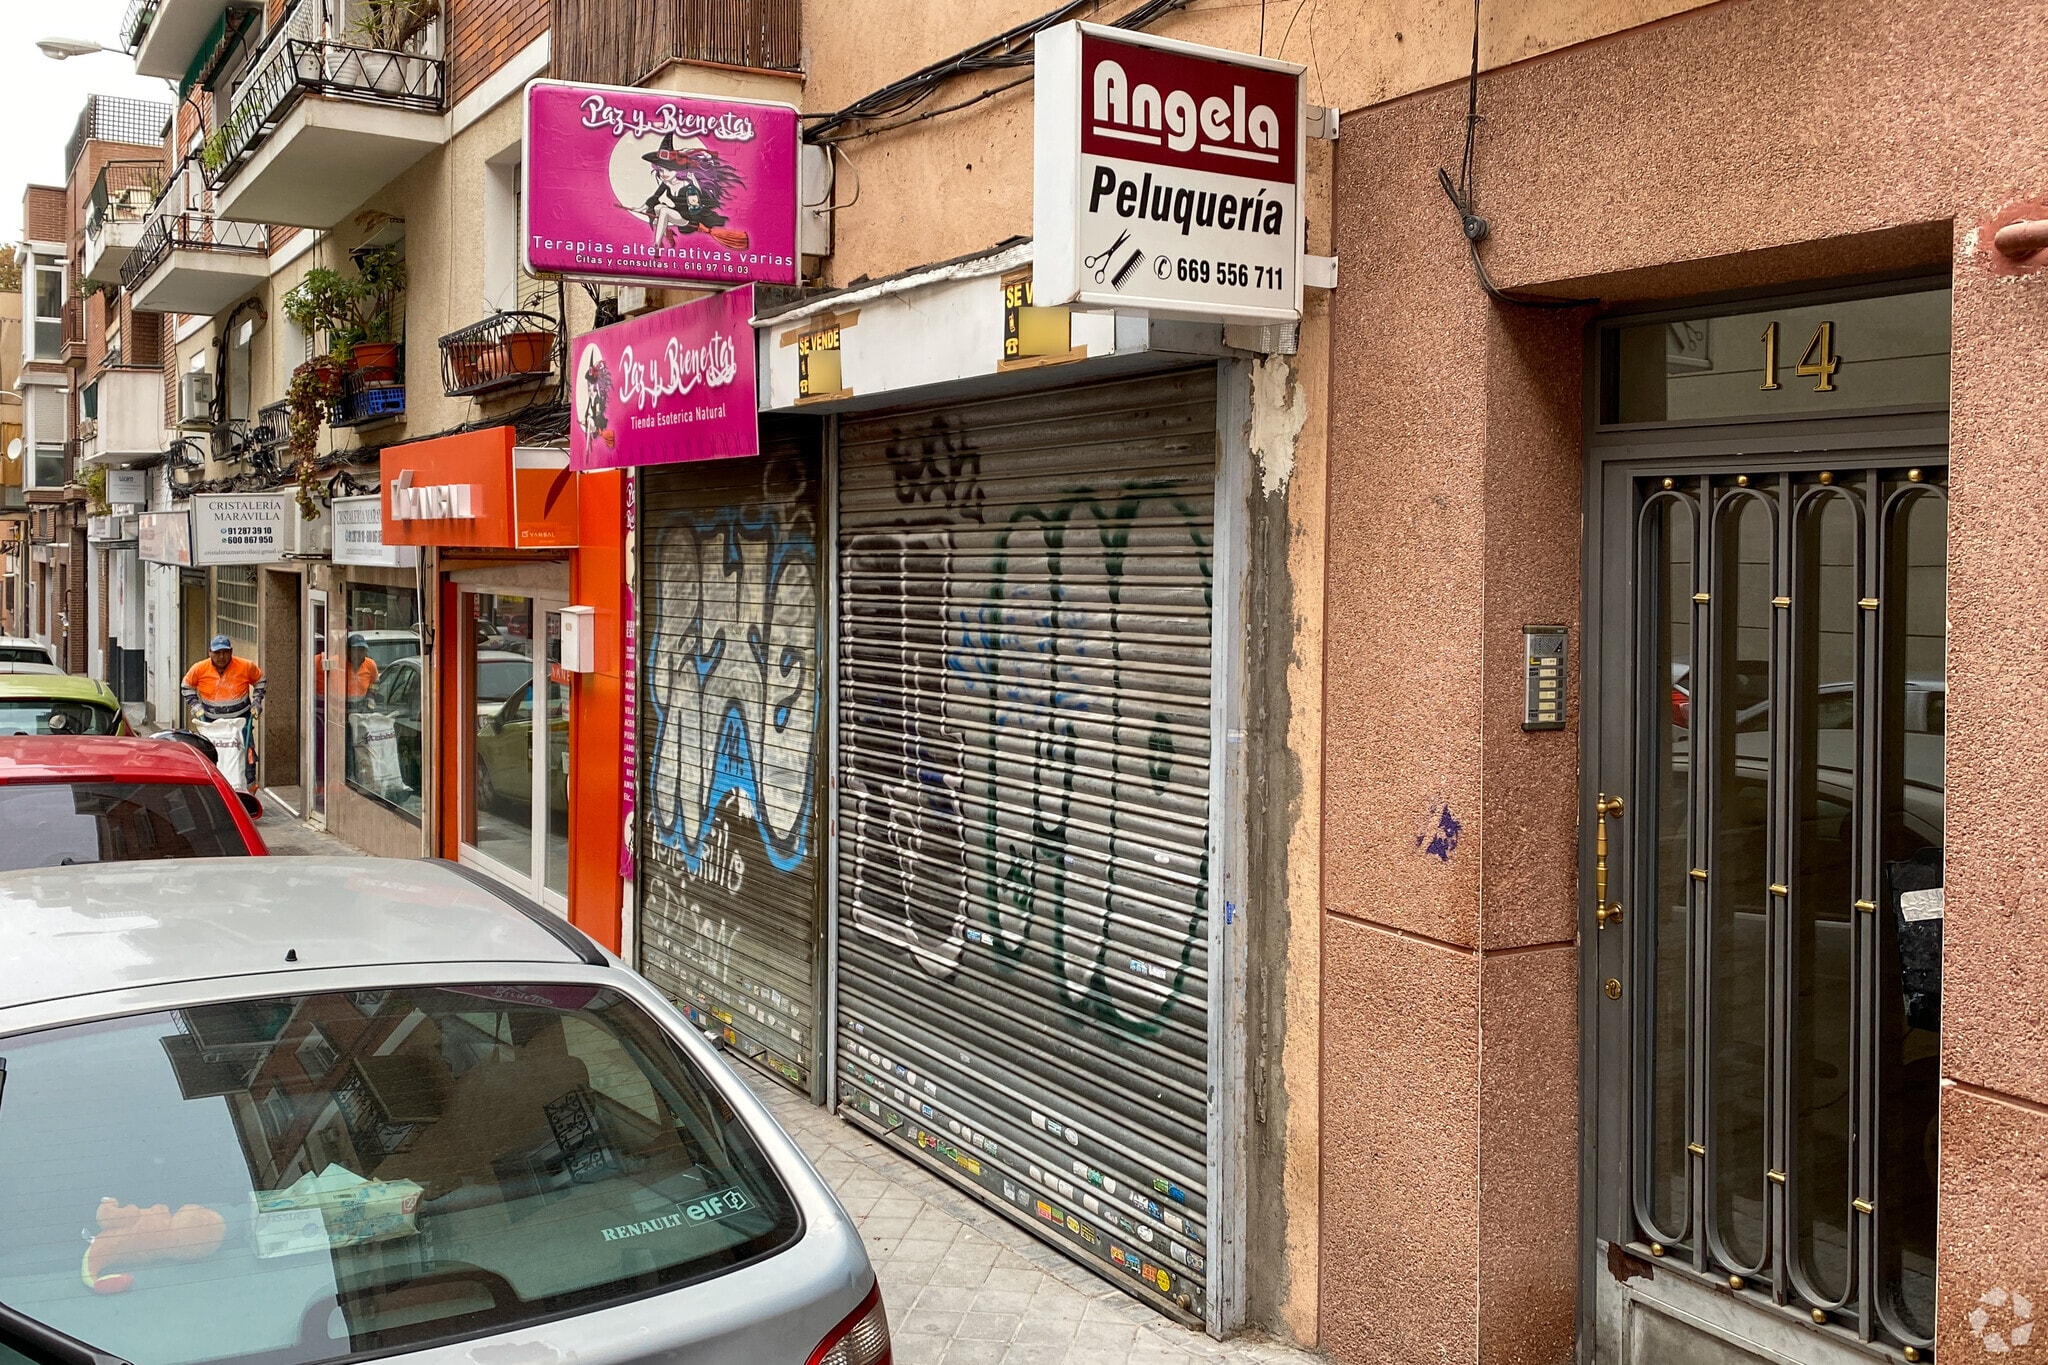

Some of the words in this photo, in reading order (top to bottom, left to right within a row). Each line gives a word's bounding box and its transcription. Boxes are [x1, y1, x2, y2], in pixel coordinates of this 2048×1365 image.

[580, 95, 625, 136] Paz
[631, 109, 652, 138] y
[651, 103, 755, 141] Bienestar
[1093, 59, 1279, 152] Angela
[1089, 165, 1284, 236] Peluquería
[532, 235, 614, 254] Terapias
[622, 242, 731, 262] alternativas
[740, 252, 793, 266] varias
[575, 254, 603, 264] Citas
[607, 258, 613, 266] y
[617, 258, 669, 269] consultas
[684, 262, 702, 271] 616
[706, 263, 718, 272] 97
[722, 264, 733, 273] 16
[737, 265, 749, 274] 03
[1177, 257, 1211, 284] 669
[1216, 262, 1249, 288] 556
[1254, 265, 1283, 291] 711
[1006, 284, 1022, 309] SE
[799, 335, 810, 356] SE
[811, 327, 840, 351] VENDE
[1760, 320, 1841, 391] 14
[618, 345, 645, 411] Paz
[649, 359, 663, 409] y
[662, 331, 737, 396] Bienestar
[630, 416, 655, 430] Tienda
[657, 409, 693, 427] Esoterica
[695, 403, 726, 420] Natural
[208, 499, 282, 510] CRISTALERÍA
[214, 512, 281, 521] MARAVILLA
[227, 527, 237, 535] 91
[237, 527, 251, 535] 287
[263, 526, 272, 534] 10
[227, 536, 243, 544] 600
[244, 536, 258, 544] 867
[258, 536, 273, 544] 950
[601, 1213, 683, 1242] RENAULT
[686, 1196, 724, 1221] elf
